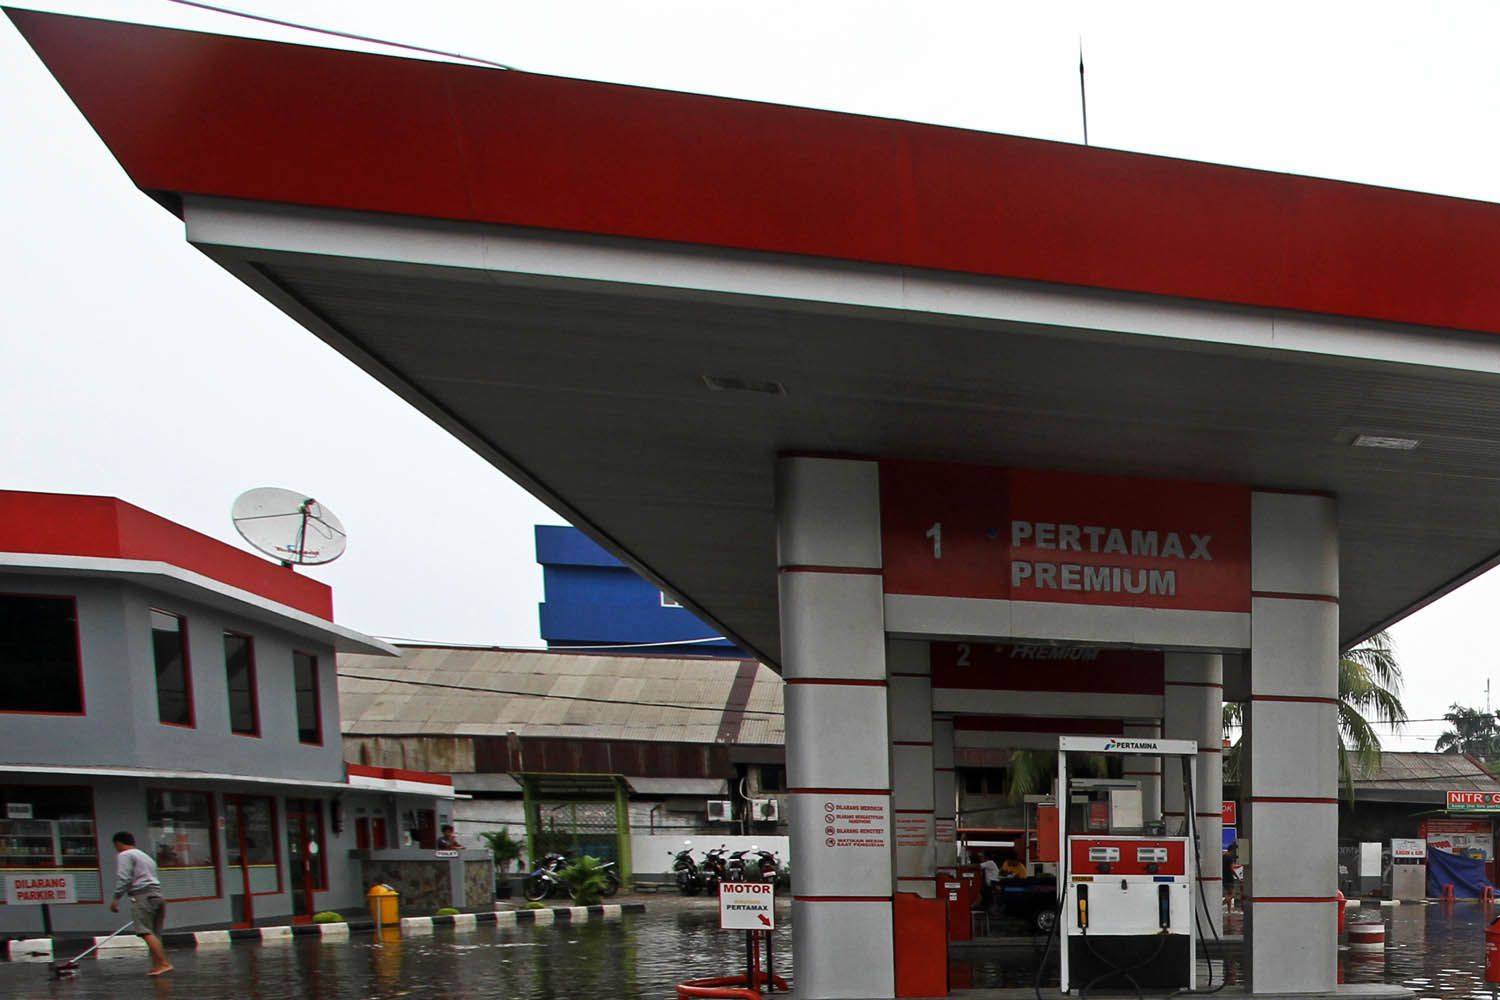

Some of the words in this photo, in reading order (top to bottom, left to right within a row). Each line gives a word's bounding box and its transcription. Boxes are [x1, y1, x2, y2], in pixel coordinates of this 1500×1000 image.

[926, 522, 943, 559] 1
[1011, 520, 1213, 561] PERTAMAX
[1011, 560, 1177, 597] PREMIUM
[956, 643, 971, 666] 2
[1116, 742, 1158, 750] PERTAMINA
[15, 878, 66, 889] DILARANG
[724, 884, 770, 894] MOTOR
[17, 890, 55, 900] PARKIR
